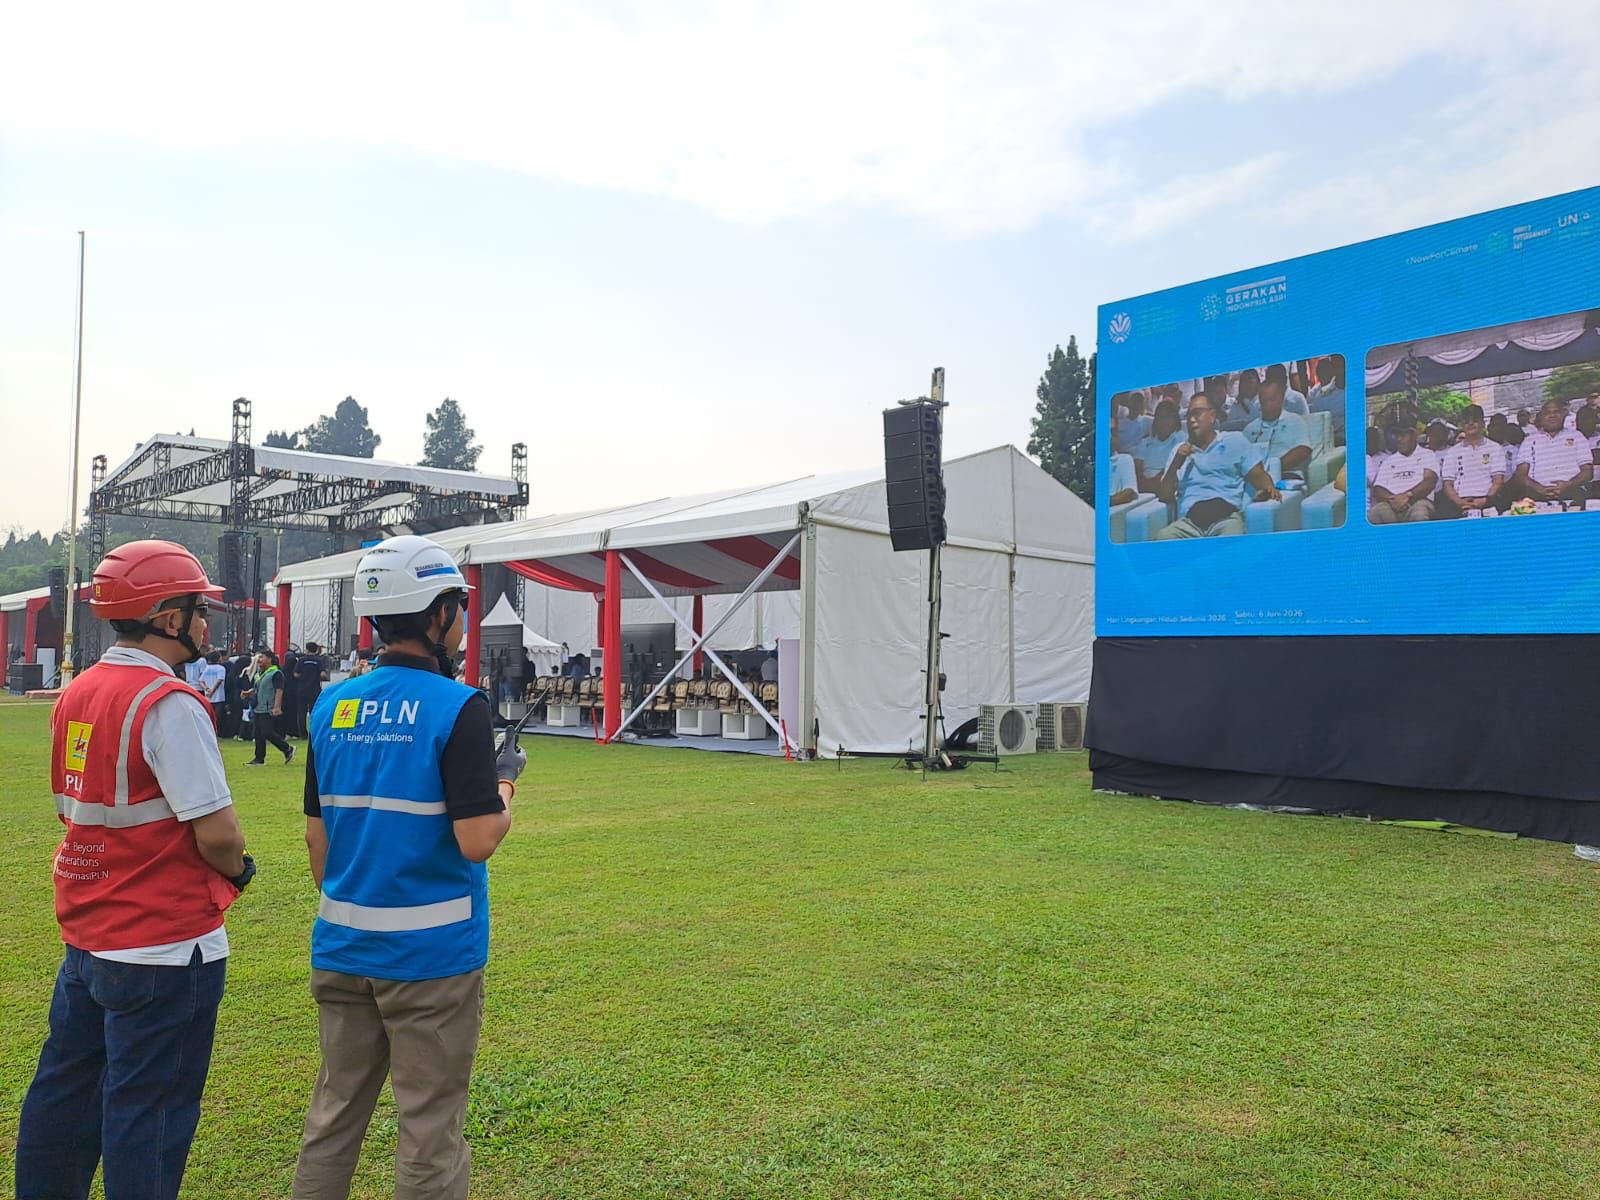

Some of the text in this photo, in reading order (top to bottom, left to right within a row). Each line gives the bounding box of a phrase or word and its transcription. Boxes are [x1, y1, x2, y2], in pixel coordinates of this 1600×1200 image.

[1226, 283, 1286, 304] GERAKAN
[361, 701, 420, 724] PLN
[347, 733, 373, 743] Energy
[377, 733, 413, 742] Solutions
[73, 841, 105, 854] Beyond
[58, 855, 99, 867] enerations
